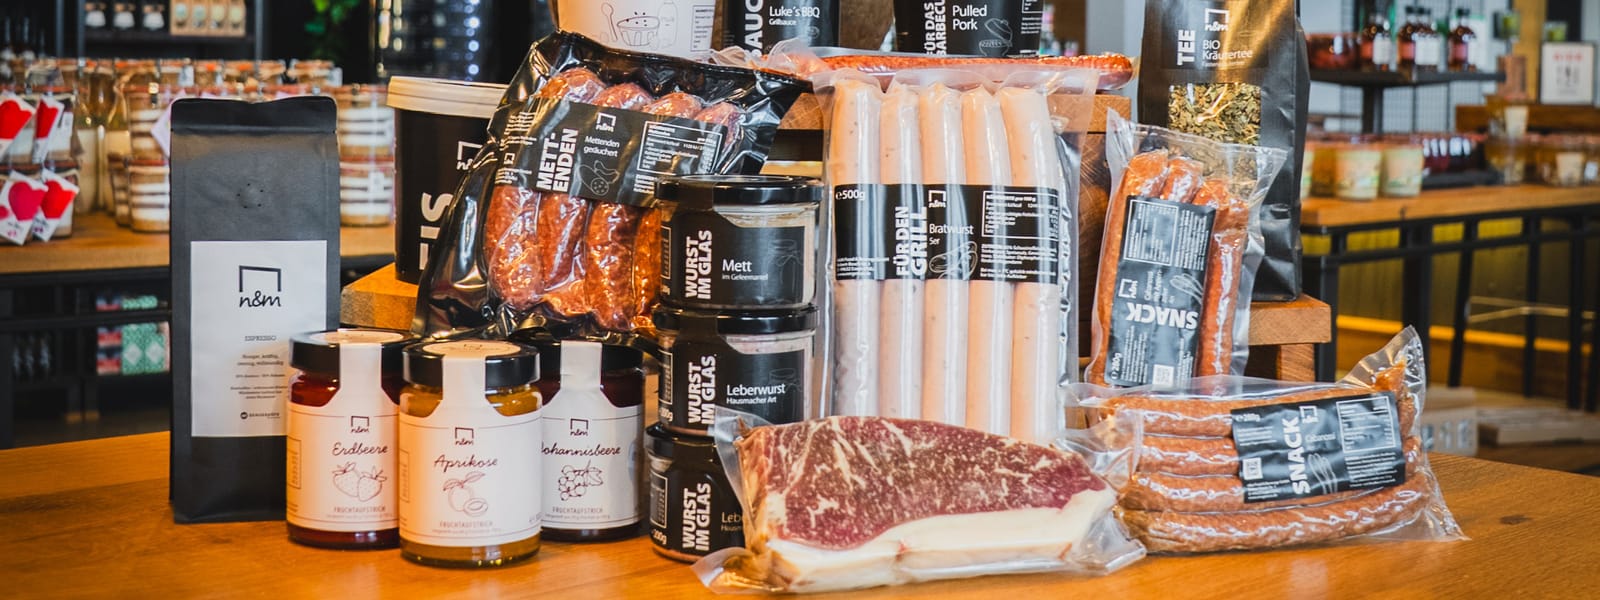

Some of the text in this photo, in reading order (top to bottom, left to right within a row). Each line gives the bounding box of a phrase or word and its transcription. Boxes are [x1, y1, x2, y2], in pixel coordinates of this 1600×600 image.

[801, 6, 820, 18] BBQ
[924, 2, 935, 30] DAS
[952, 4, 987, 17] Pulled
[952, 18, 978, 31] Pork
[1177, 29, 1195, 66] TEE
[1202, 39, 1221, 50] BIO
[1202, 50, 1253, 60] Kräutertee
[583, 146, 618, 157] geräuchert
[584, 136, 620, 148] Mettenden
[536, 132, 560, 190] METT-
[553, 128, 579, 192] ENDEN
[929, 223, 974, 235] Bratwurst
[893, 206, 910, 276] FÜR DEN
[910, 206, 928, 276] GRILL
[685, 236, 699, 298] WURST
[697, 230, 712, 300] IM GLAS
[722, 259, 752, 272] Mett
[239, 290, 282, 308] n&m
[1126, 302, 1199, 330] SNACK
[688, 362, 702, 424] WURST
[701, 355, 716, 425] IM GLAS
[726, 383, 786, 396] Leberwurst
[726, 397, 767, 405] Hausmacher
[332, 442, 389, 456] Erdbeere
[1283, 416, 1311, 495] SNACK
[434, 454, 499, 473] Aprikose
[682, 488, 697, 549] WURST
[695, 482, 712, 551] IM GLAS
